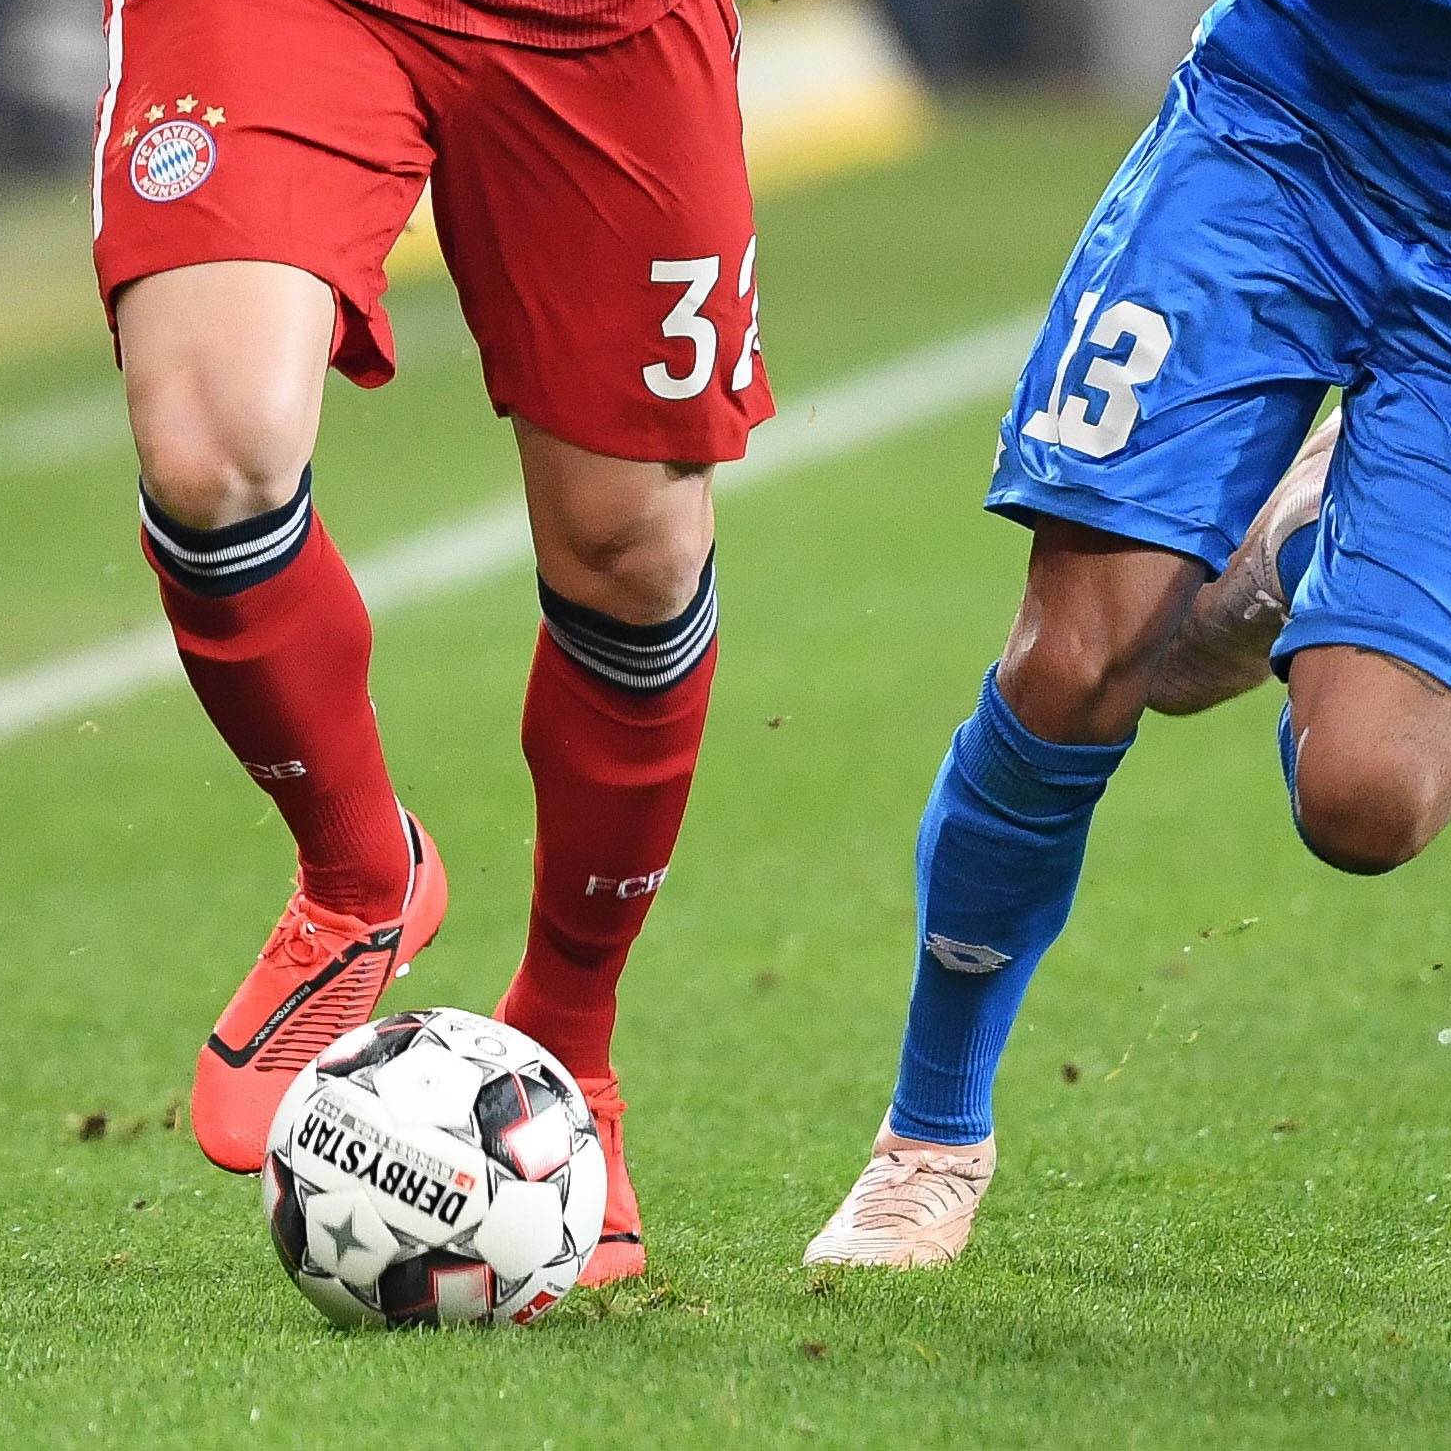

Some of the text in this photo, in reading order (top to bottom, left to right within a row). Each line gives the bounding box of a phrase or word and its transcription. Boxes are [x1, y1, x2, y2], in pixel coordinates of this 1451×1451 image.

[151, 126, 207, 151] BAYERN
[1021, 291, 1172, 459] 13
[298, 1113, 468, 1227] DERBYSTAR
